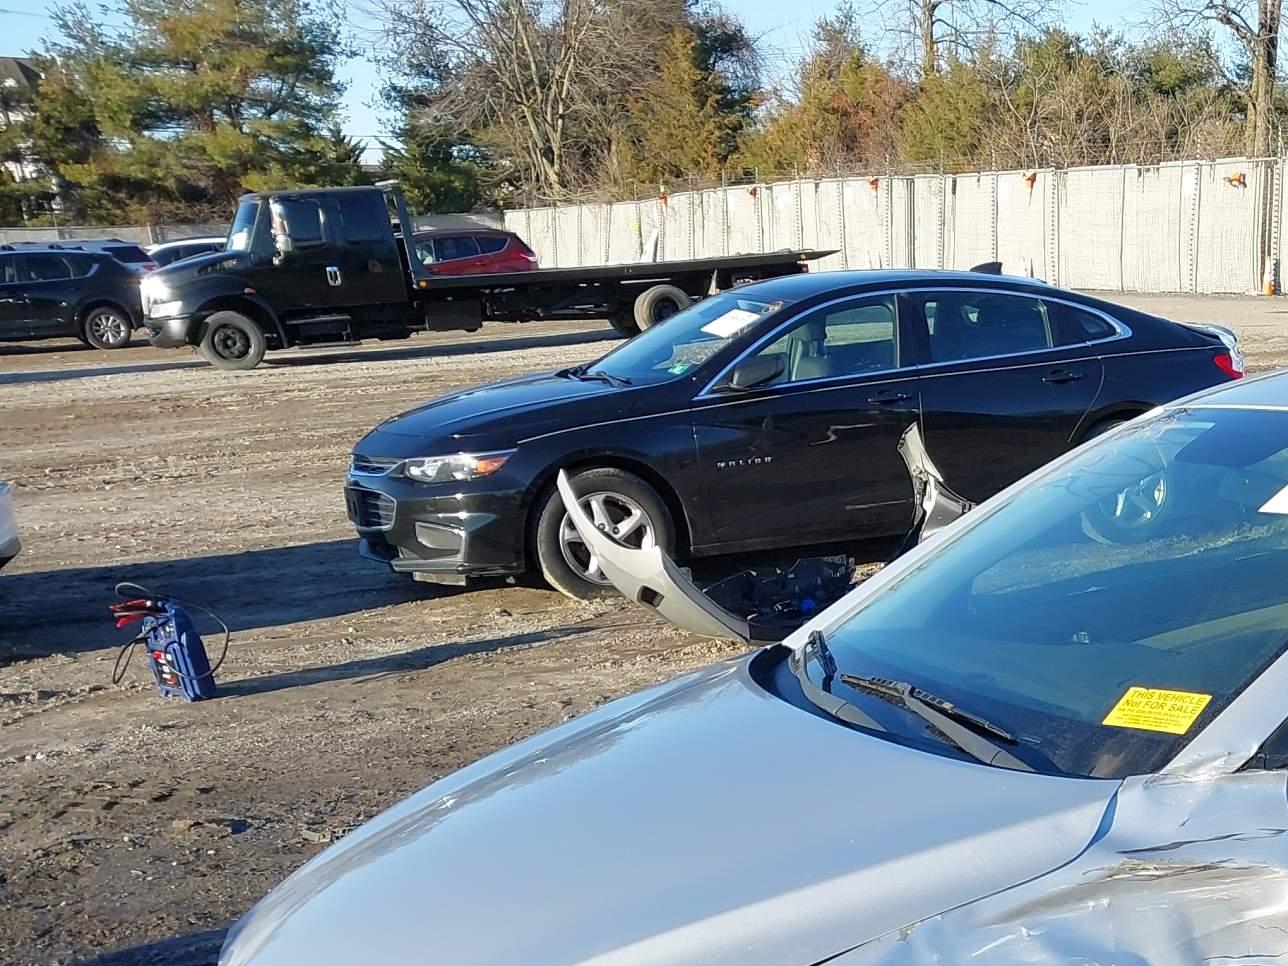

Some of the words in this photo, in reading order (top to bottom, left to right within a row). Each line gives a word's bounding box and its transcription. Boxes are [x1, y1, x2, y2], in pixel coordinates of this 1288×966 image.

[1130, 690, 1156, 700] THIS
[1156, 692, 1207, 706] VEHICLE
[1142, 701, 1167, 711] FOR
[1168, 703, 1201, 715] SALE
